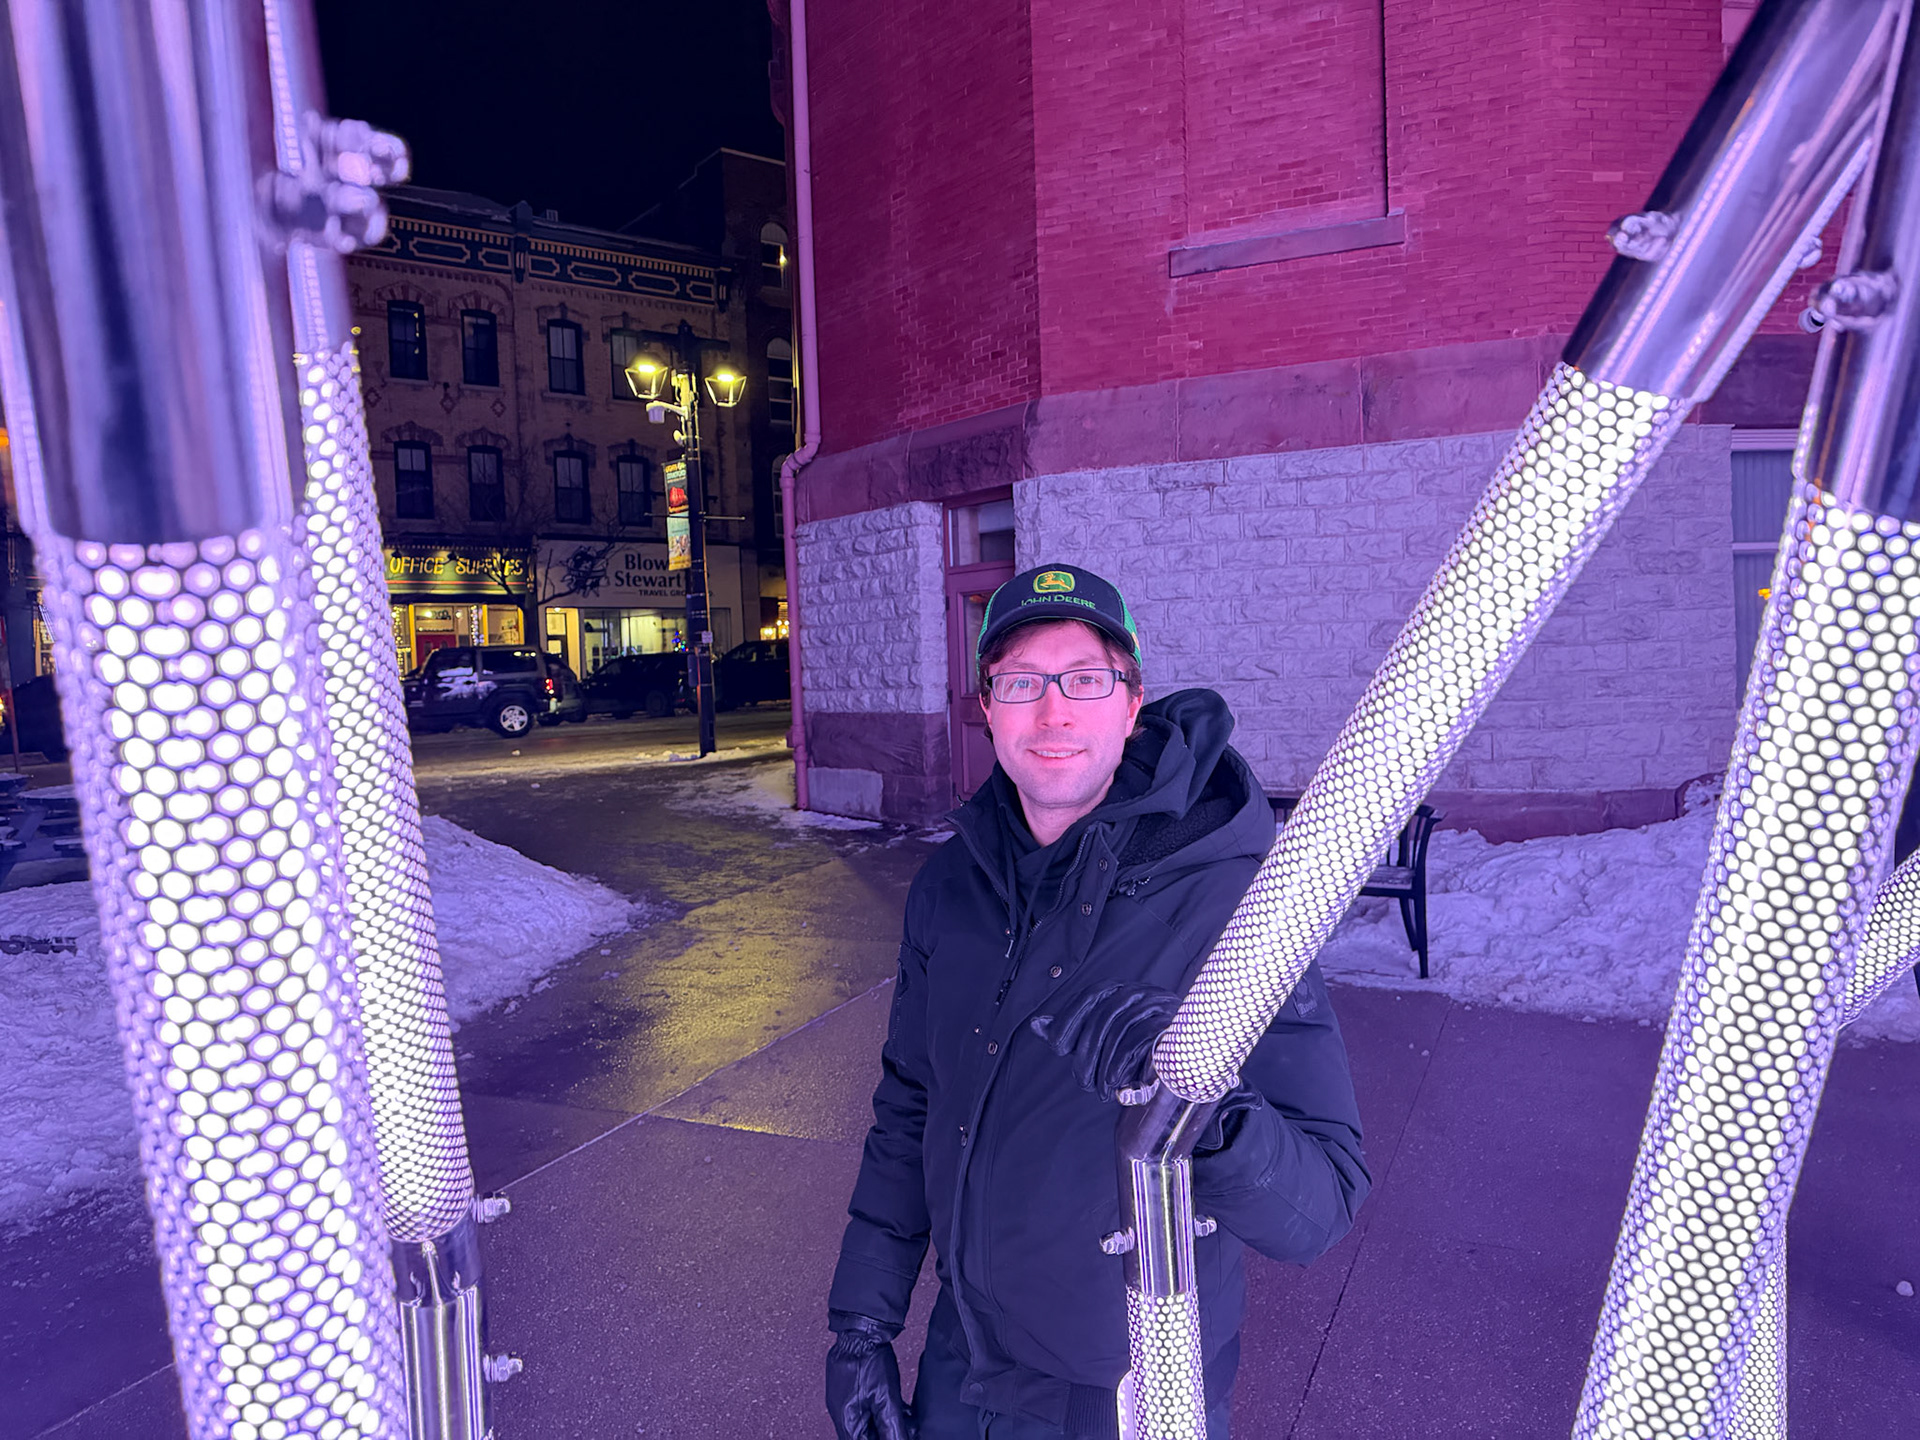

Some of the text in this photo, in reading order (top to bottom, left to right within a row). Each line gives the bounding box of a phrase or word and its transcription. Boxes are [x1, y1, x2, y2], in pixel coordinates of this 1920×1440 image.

[614, 570, 682, 588] Stewart
[639, 589, 668, 597] TRAVEL
[1021, 594, 1097, 610] JOHN DEERE
